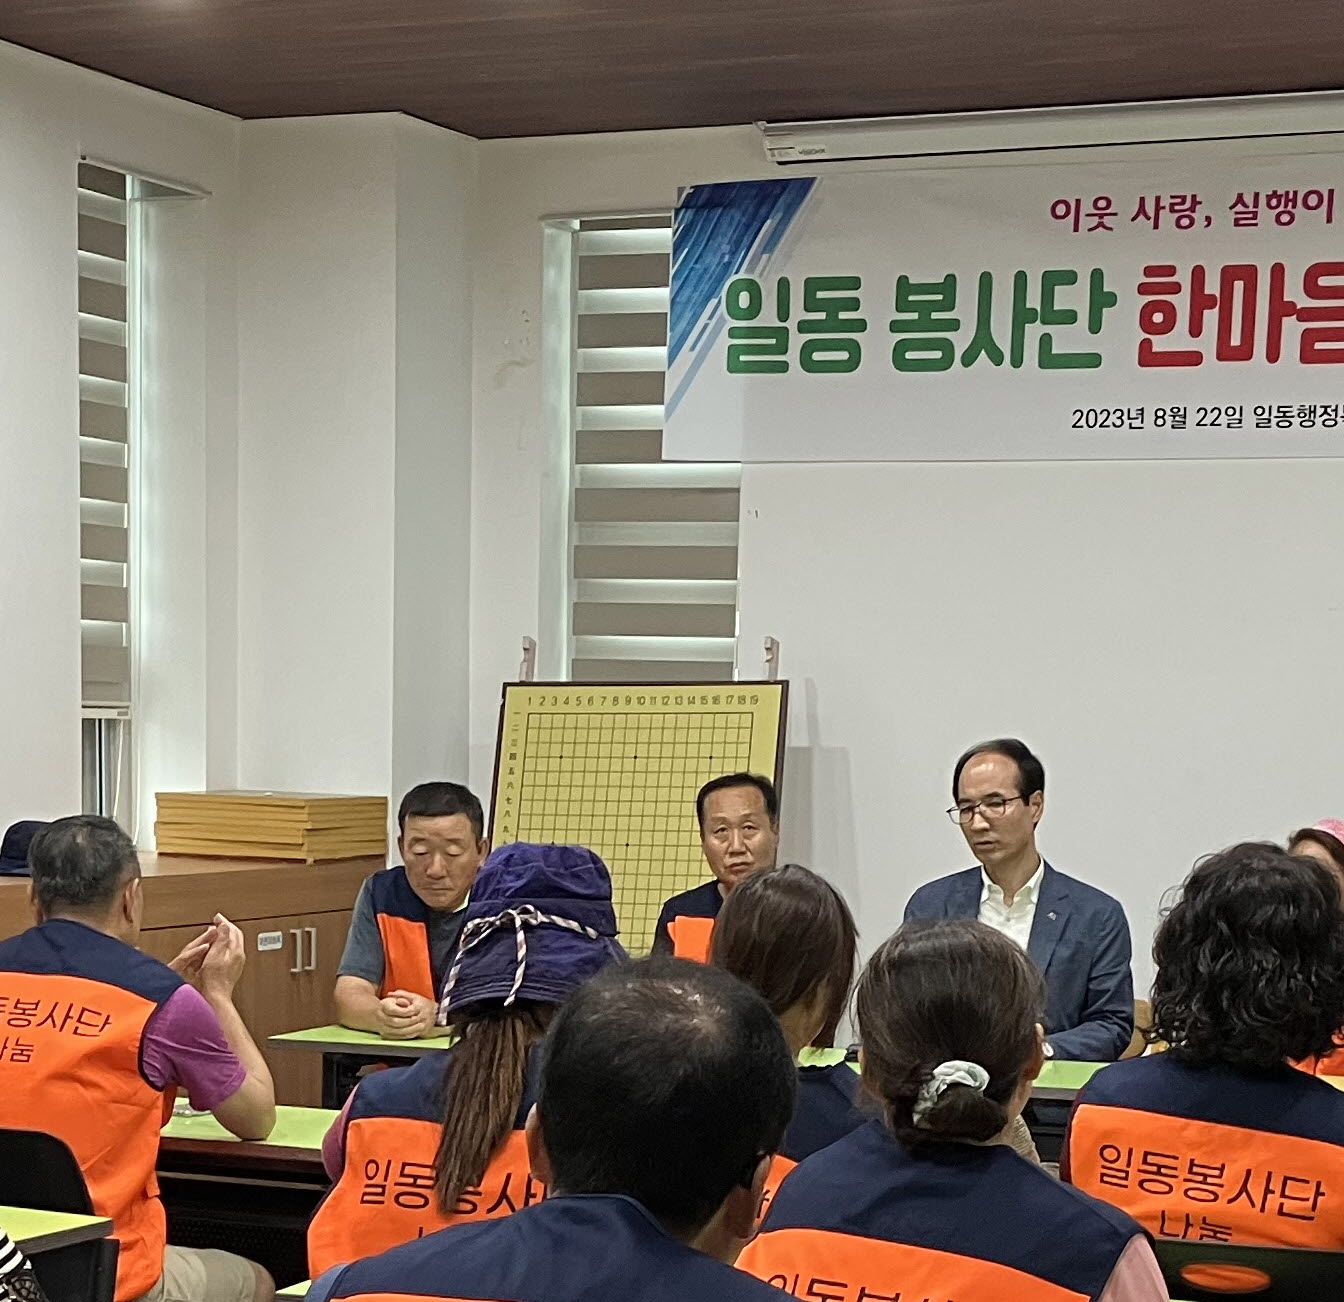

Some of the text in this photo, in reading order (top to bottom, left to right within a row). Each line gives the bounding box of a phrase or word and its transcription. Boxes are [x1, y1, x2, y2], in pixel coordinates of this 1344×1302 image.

[1050, 196, 1119, 234] 이웃
[1130, 194, 1213, 231] 사랑,
[1228, 188, 1335, 228] 실행이
[724, 275, 868, 375] 일동
[889, 267, 1118, 372] 봉사단
[1071, 407, 1146, 430] 2023년
[1153, 406, 1188, 429] 8월
[1195, 405, 1245, 429] 22일
[528, 695, 759, 706] 1 2 3 4 5 6 7 8 9 10 11 12 13 14 15 16 17 18 19
[360, 1159, 548, 1214] 일동사
[1099, 1144, 1326, 1221] 일동봉사단
